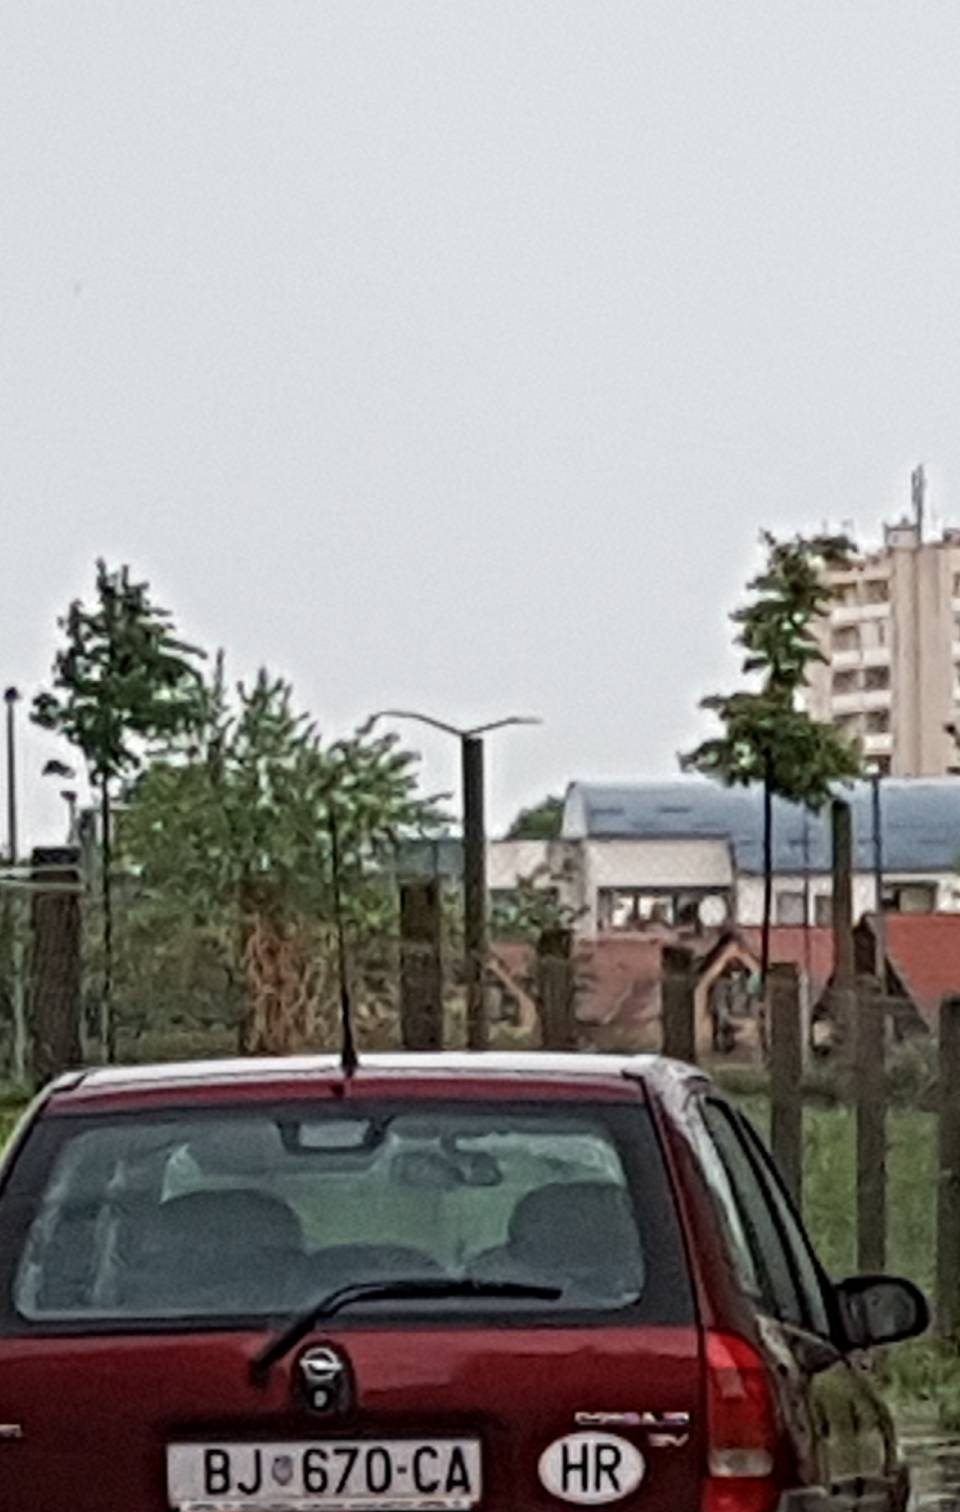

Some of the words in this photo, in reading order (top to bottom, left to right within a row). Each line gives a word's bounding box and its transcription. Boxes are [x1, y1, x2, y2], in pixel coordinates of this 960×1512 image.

[204, 1448, 262, 1495] BJ
[301, 1445, 471, 1494] 670-CA
[561, 1442, 622, 1493] HR
